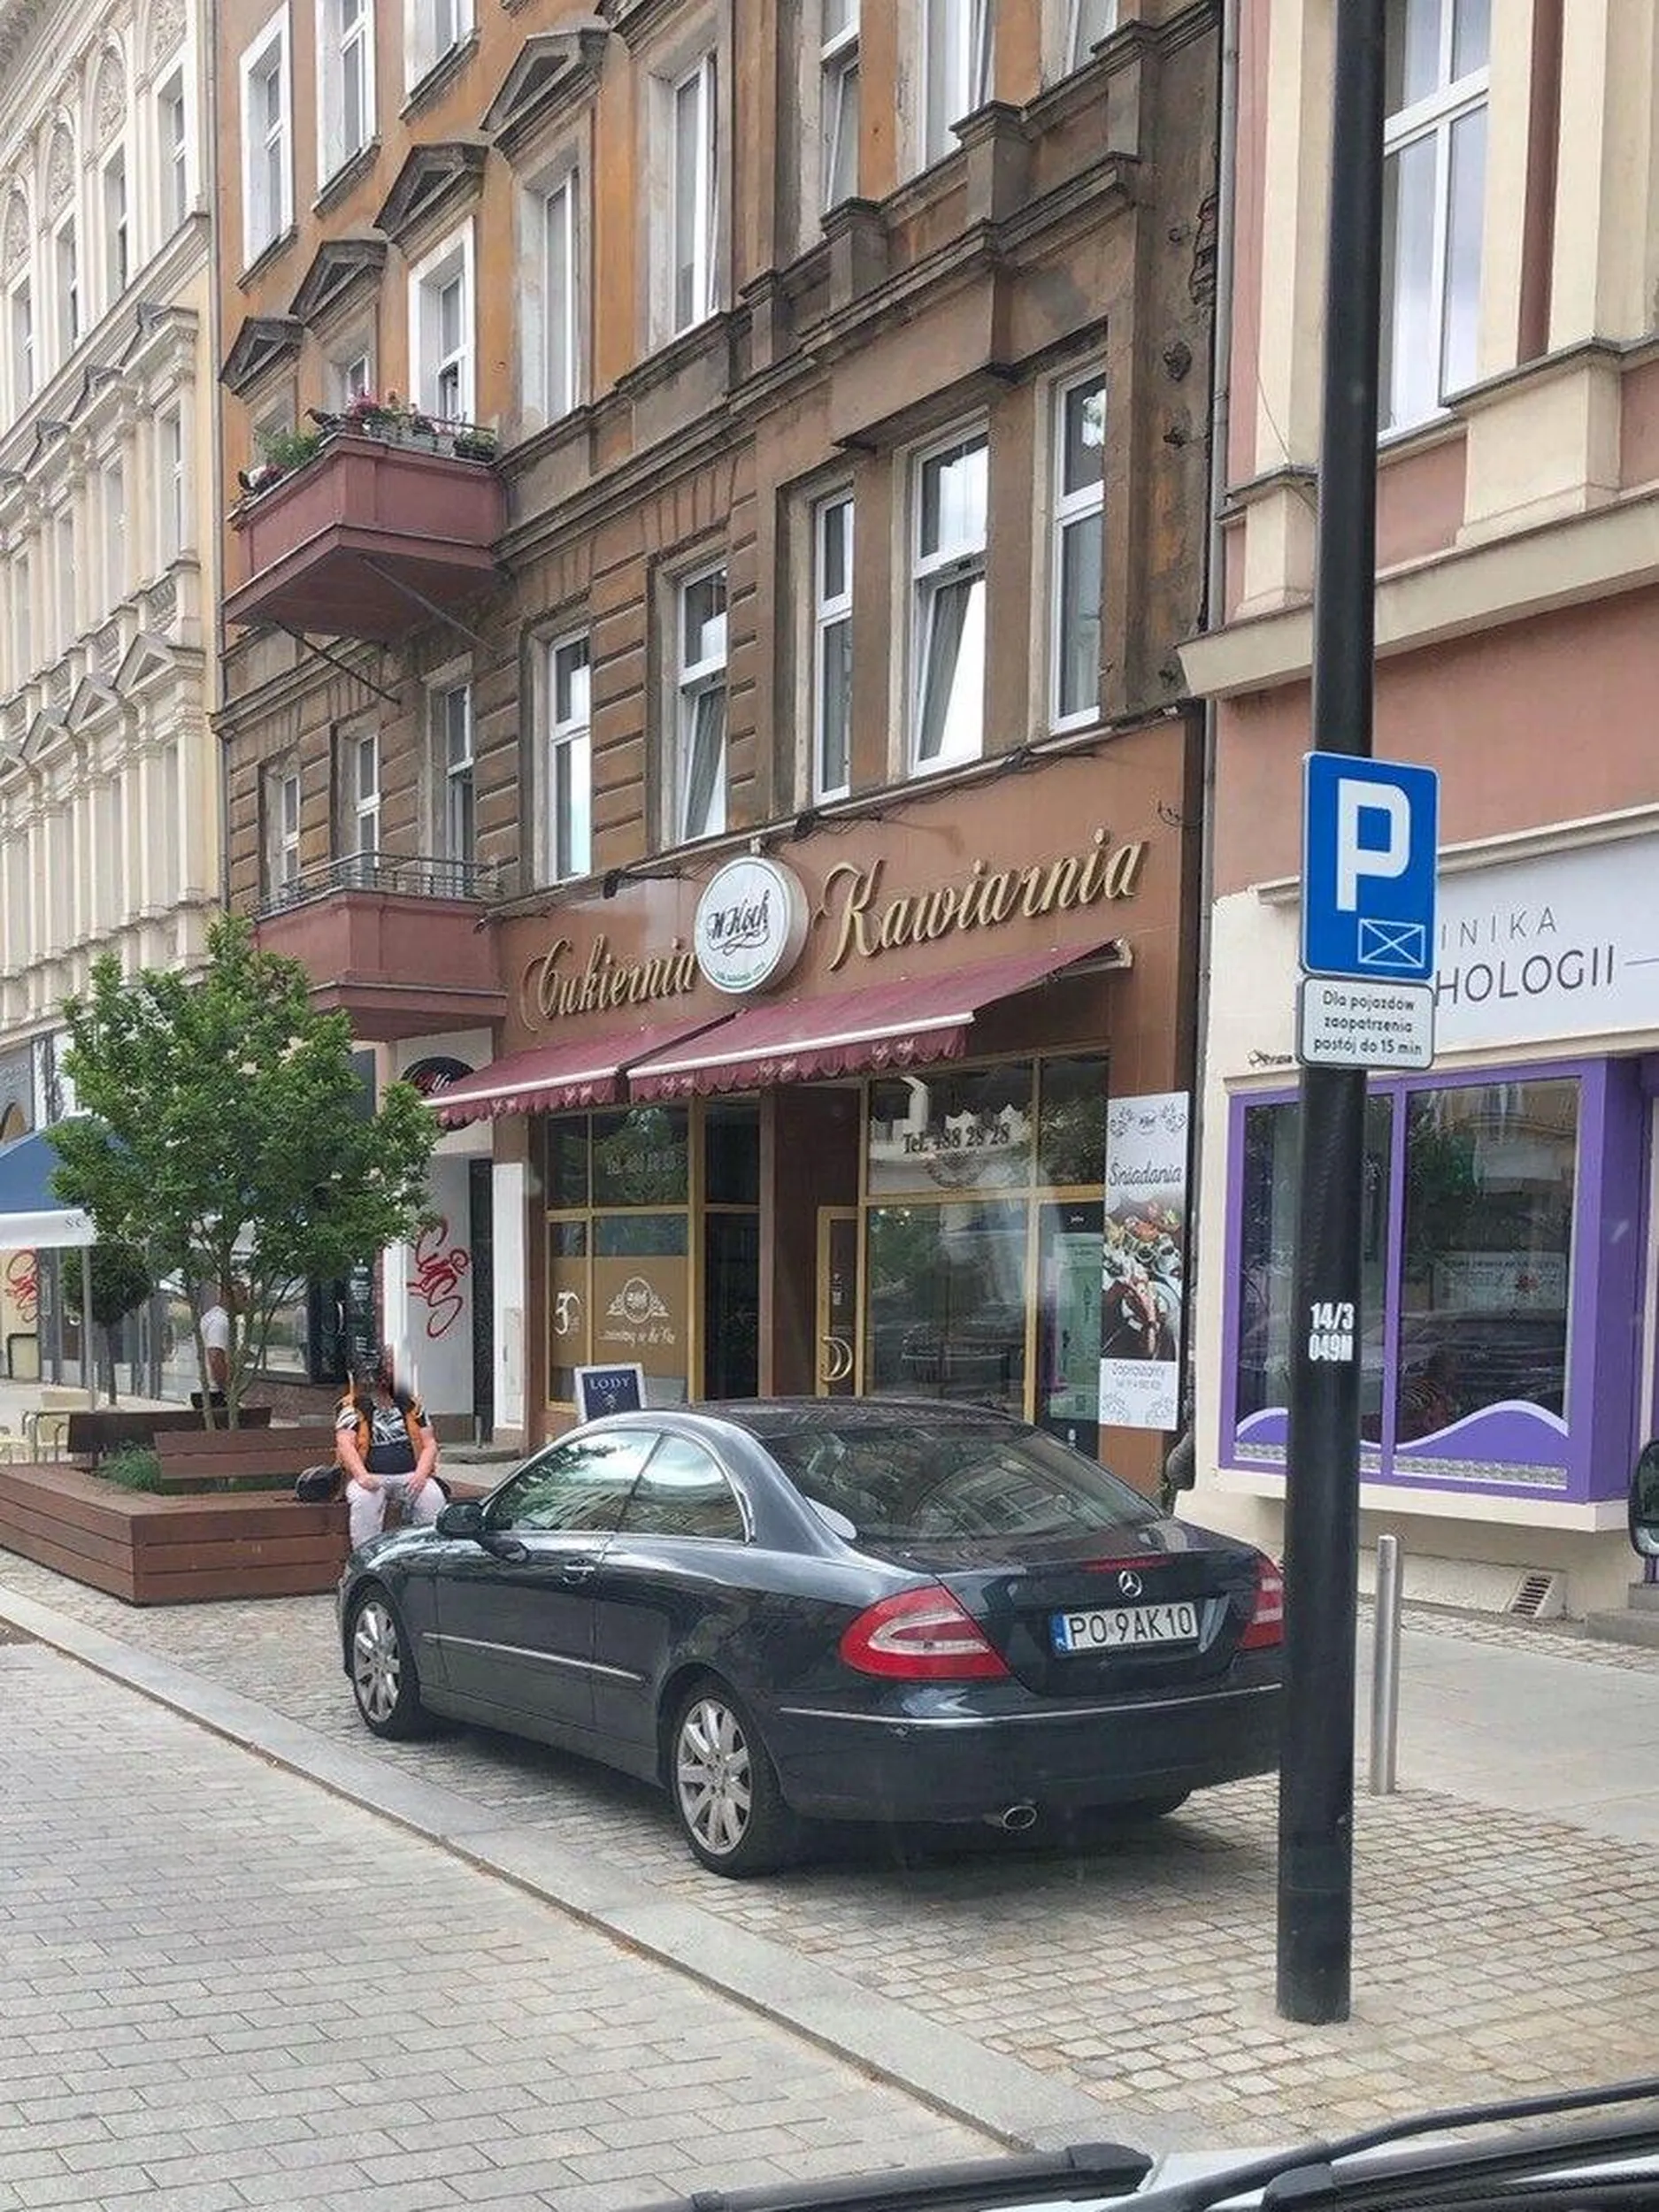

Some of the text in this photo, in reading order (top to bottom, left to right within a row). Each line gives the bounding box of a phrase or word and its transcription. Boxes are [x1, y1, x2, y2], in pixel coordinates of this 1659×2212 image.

[1336, 778, 1412, 912] P
[811, 828, 1149, 972] Kawiarnia
[1440, 907, 1558, 951] INIKA
[519, 933, 695, 1033] Cukiernia
[1435, 944, 1614, 1007] HOLOGII
[1323, 989, 1415, 1012] Dla pojazdów
[1325, 1016, 1413, 1034] zaopatrzenia
[1314, 1037, 1423, 1056] postój do 15 min
[1310, 1302, 1356, 1330] 14/3
[589, 1376, 631, 1390] LODY
[1069, 1614, 1108, 1647] PO
[1115, 1606, 1194, 1642] 9AK10
